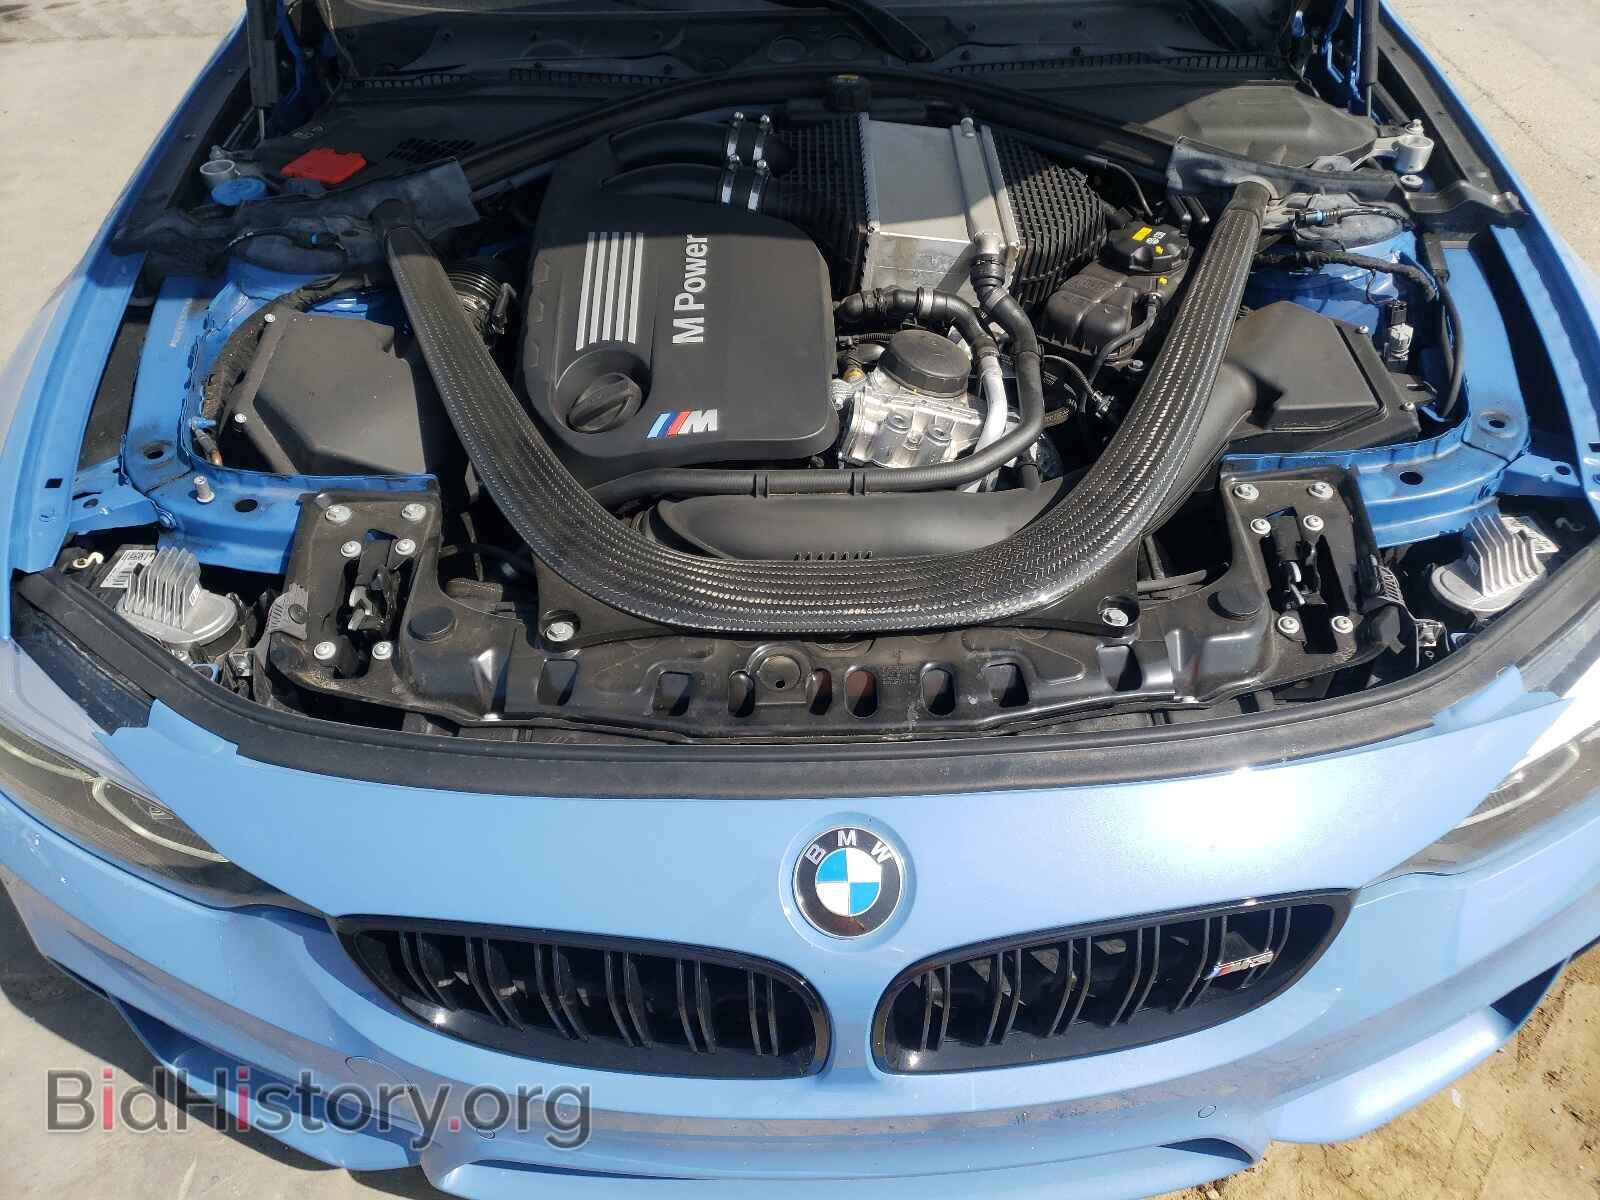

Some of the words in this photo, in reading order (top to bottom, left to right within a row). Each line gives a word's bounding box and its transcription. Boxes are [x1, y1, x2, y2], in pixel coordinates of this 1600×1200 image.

[673, 233, 709, 312] Power
[671, 317, 705, 345] M
[804, 829, 893, 866] BMW
